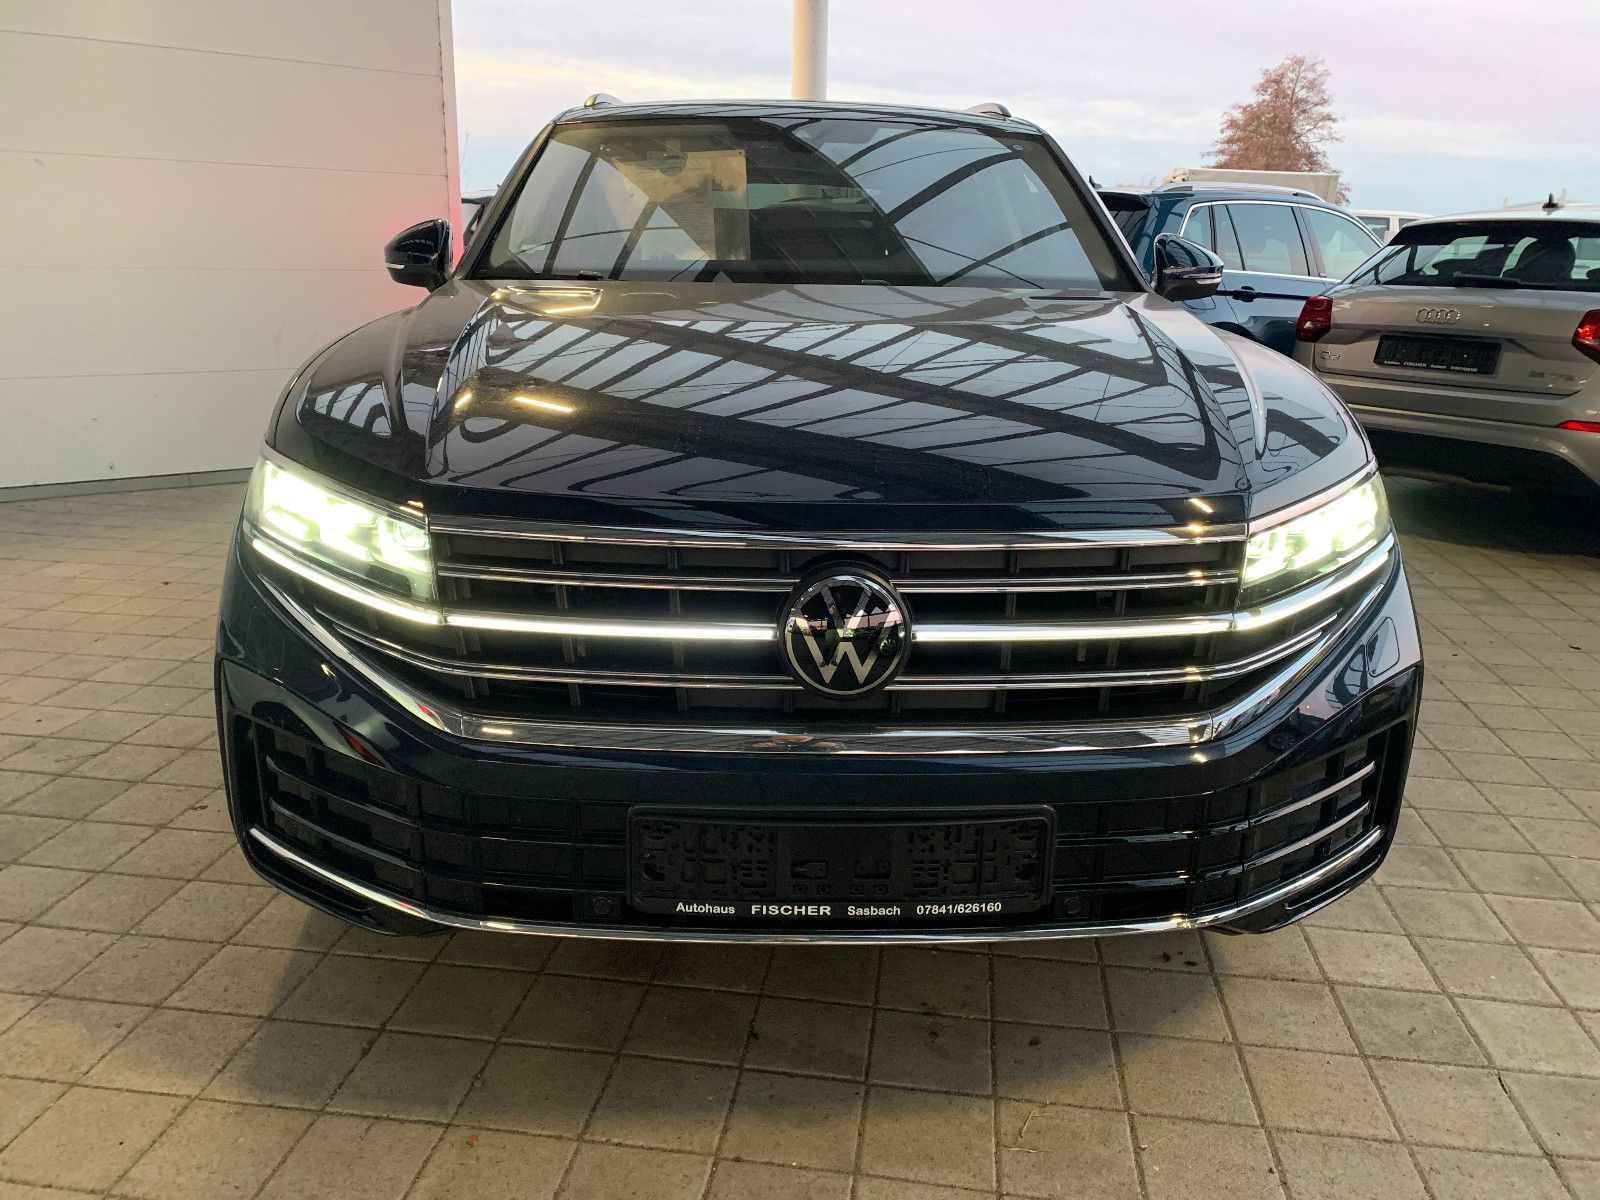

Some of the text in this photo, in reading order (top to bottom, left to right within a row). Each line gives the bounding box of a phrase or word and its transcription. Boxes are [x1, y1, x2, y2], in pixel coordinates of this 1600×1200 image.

[788, 580, 901, 687] VW
[675, 902, 1002, 916] Autohaus FISCHER Sasbach 07841/626160
